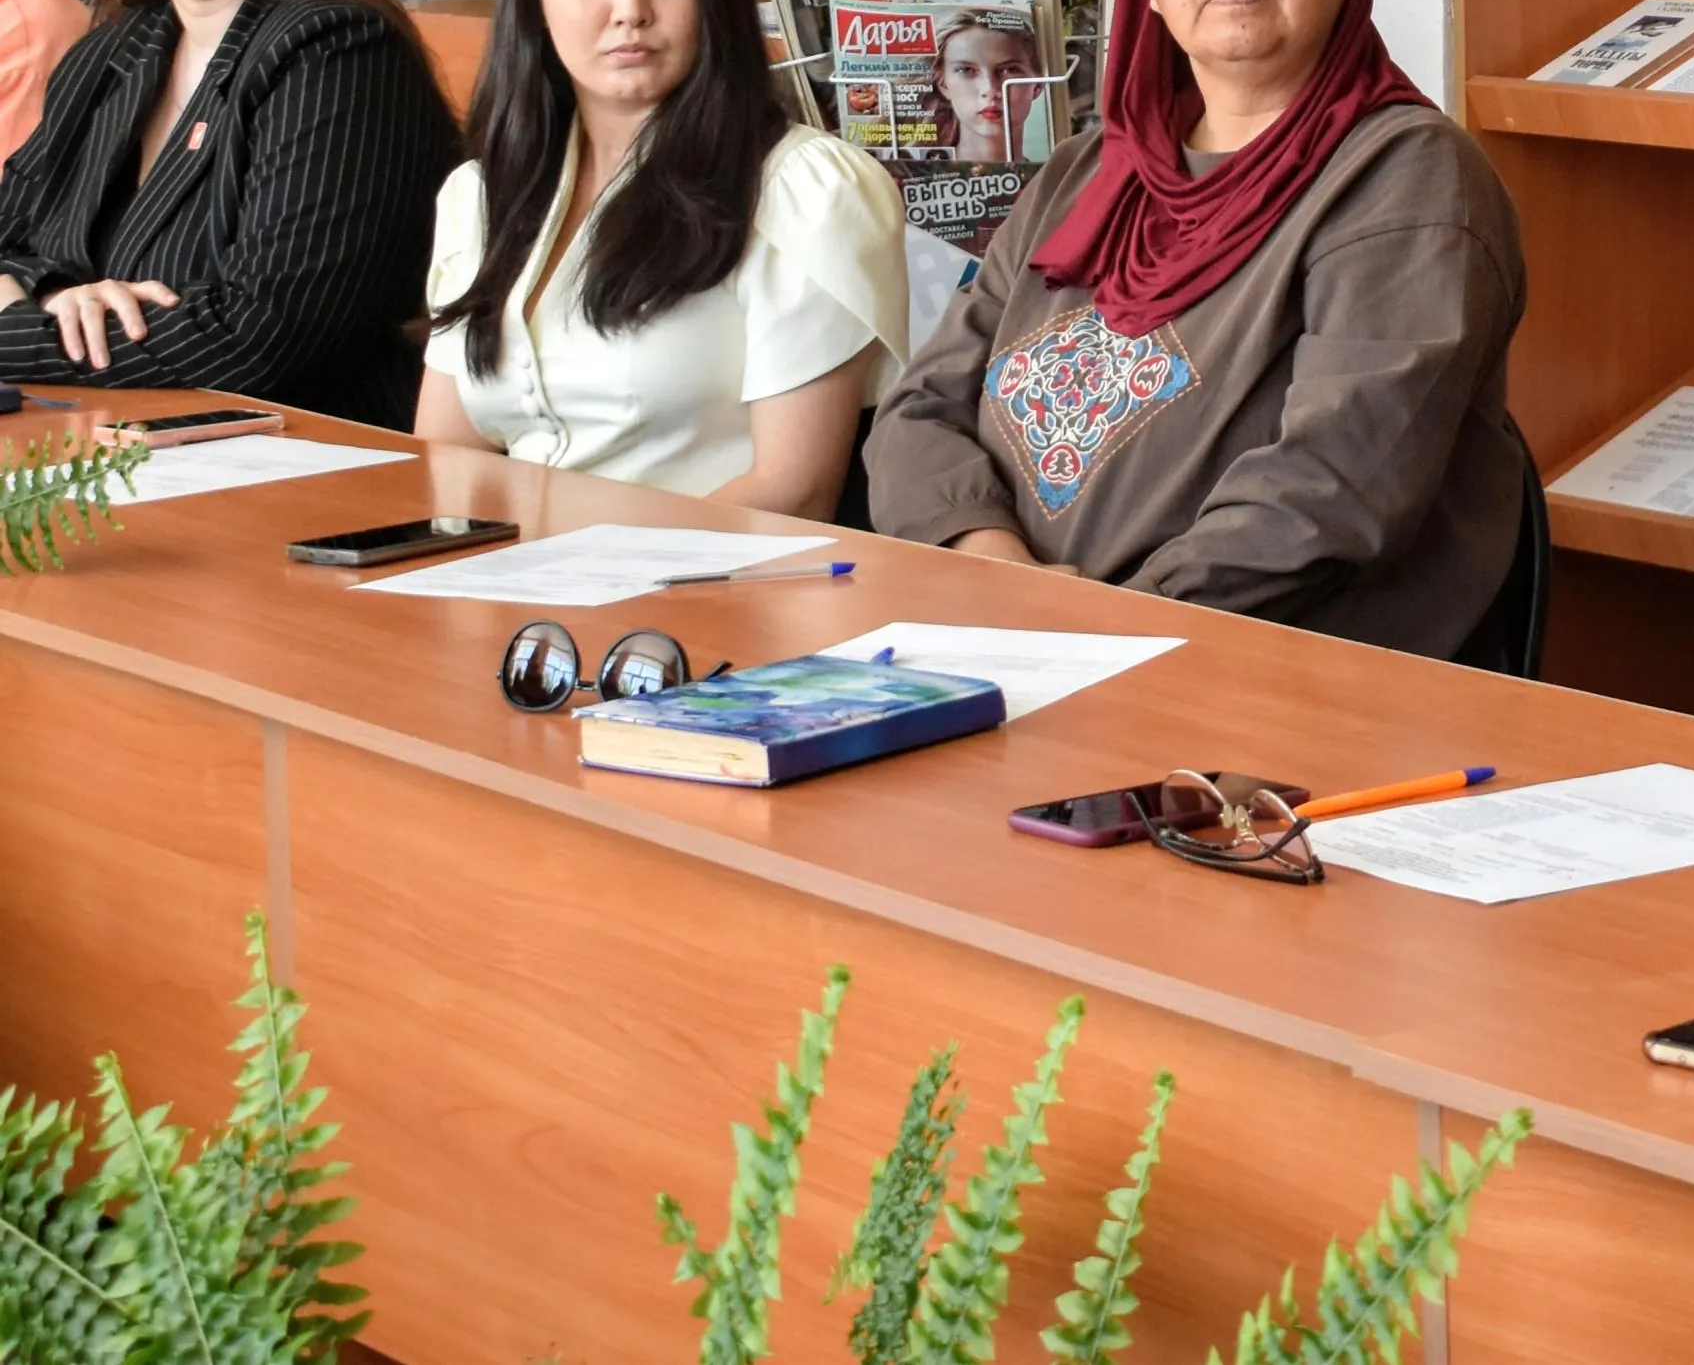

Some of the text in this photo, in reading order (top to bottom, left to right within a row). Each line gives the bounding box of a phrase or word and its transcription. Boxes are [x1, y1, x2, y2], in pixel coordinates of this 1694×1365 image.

[842, 15, 928, 59] Дарья
[842, 60, 930, 74] Легкий загар
[847, 122, 857, 141] 7
[916, 123, 937, 133] для
[914, 133, 938, 141] глаз
[905, 174, 1020, 205] ВЫГОДНО
[909, 198, 985, 224] ОЧЕНЬ
